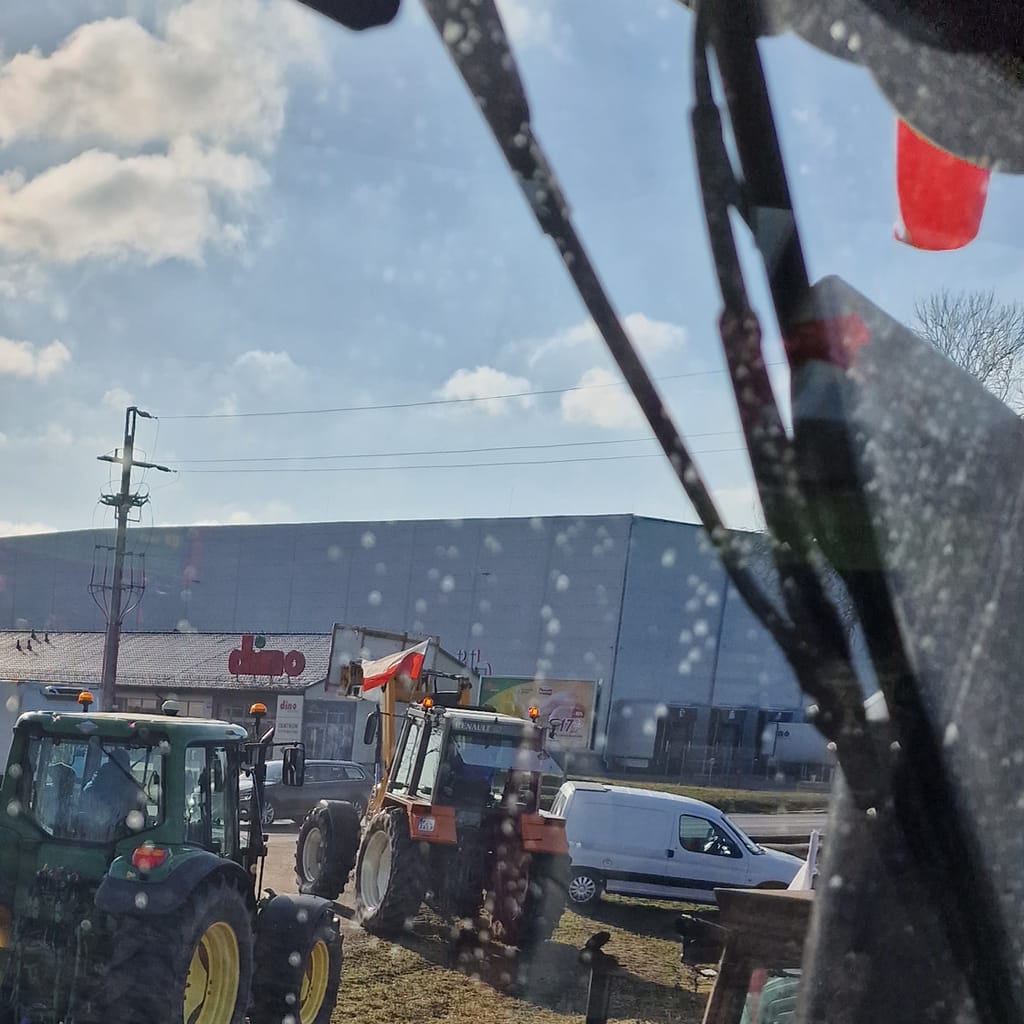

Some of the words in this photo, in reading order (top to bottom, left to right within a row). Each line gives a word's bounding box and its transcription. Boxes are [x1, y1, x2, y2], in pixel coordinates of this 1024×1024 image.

[228, 633, 305, 676] dino
[280, 700, 297, 710] dino
[454, 719, 492, 732] RENAULT
